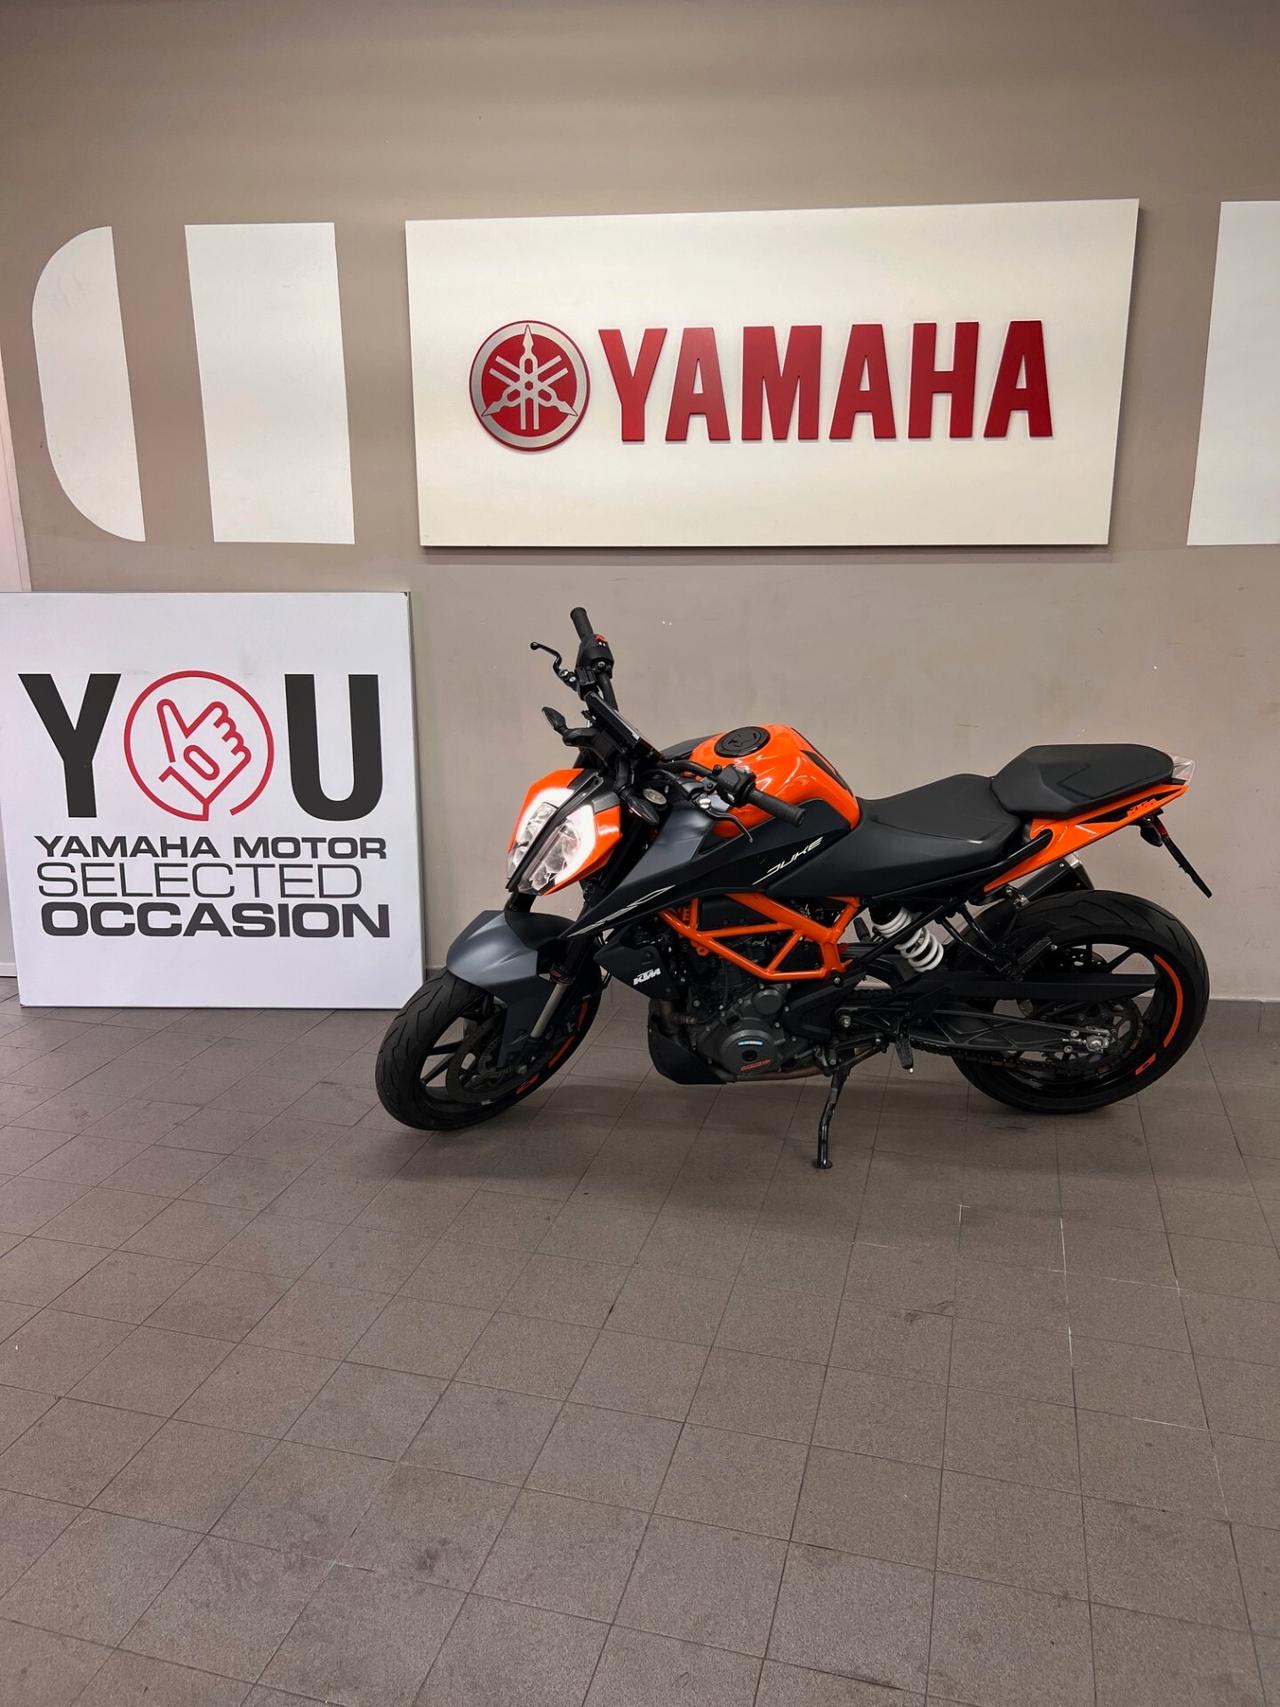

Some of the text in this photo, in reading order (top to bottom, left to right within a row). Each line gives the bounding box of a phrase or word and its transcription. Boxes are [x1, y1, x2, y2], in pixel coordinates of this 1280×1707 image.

[598, 320, 1053, 442] YAMAHA
[34, 835, 387, 860] YAMAHA MOTOR
[752, 836, 823, 885] DUKE
[36, 861, 362, 899] SELECTED
[41, 901, 391, 938] OCCASION
[633, 967, 661, 986] KTM
